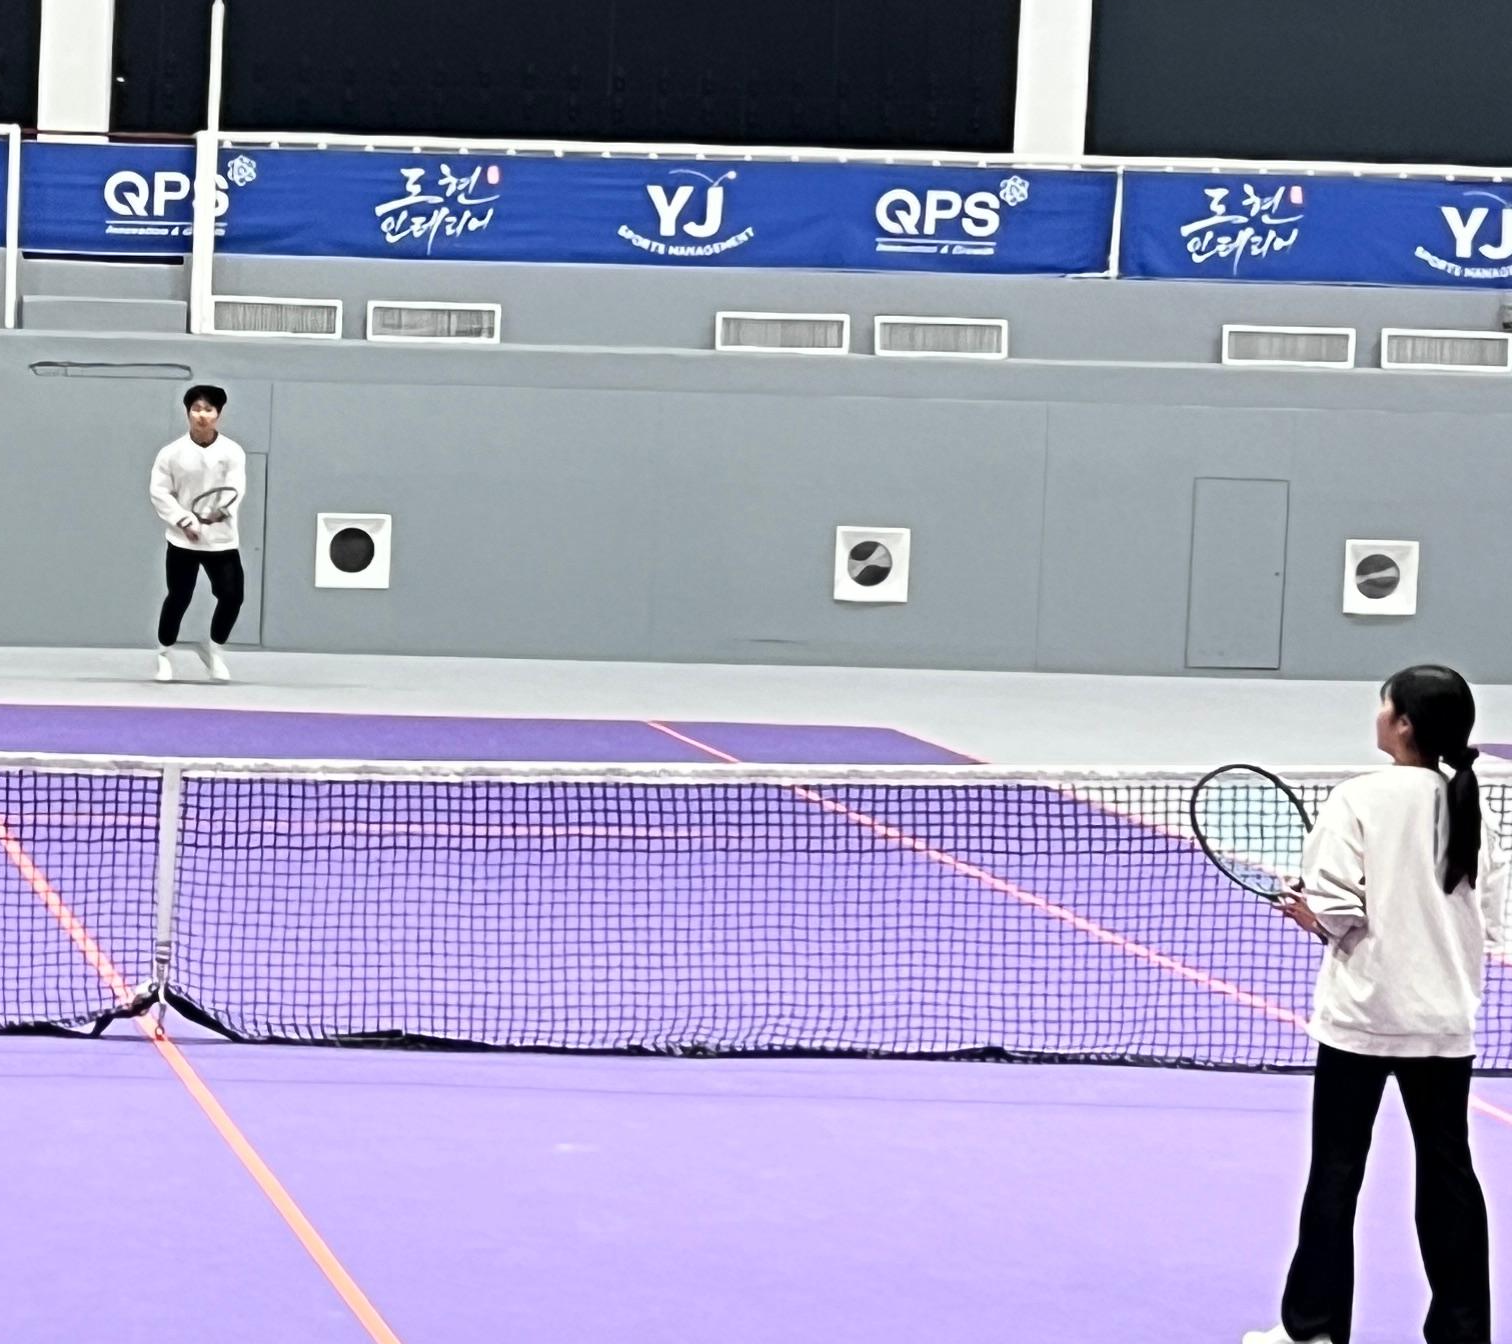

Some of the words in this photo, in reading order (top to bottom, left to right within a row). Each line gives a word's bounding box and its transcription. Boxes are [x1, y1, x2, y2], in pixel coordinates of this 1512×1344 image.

[381, 207, 494, 255] 인테리어
[646, 185, 724, 238] YJ
[875, 188, 1000, 237] QPS
[1440, 206, 1512, 260] YJ
[667, 226, 754, 256] MANAGEMENT
[1187, 227, 1299, 275] 인테리어
